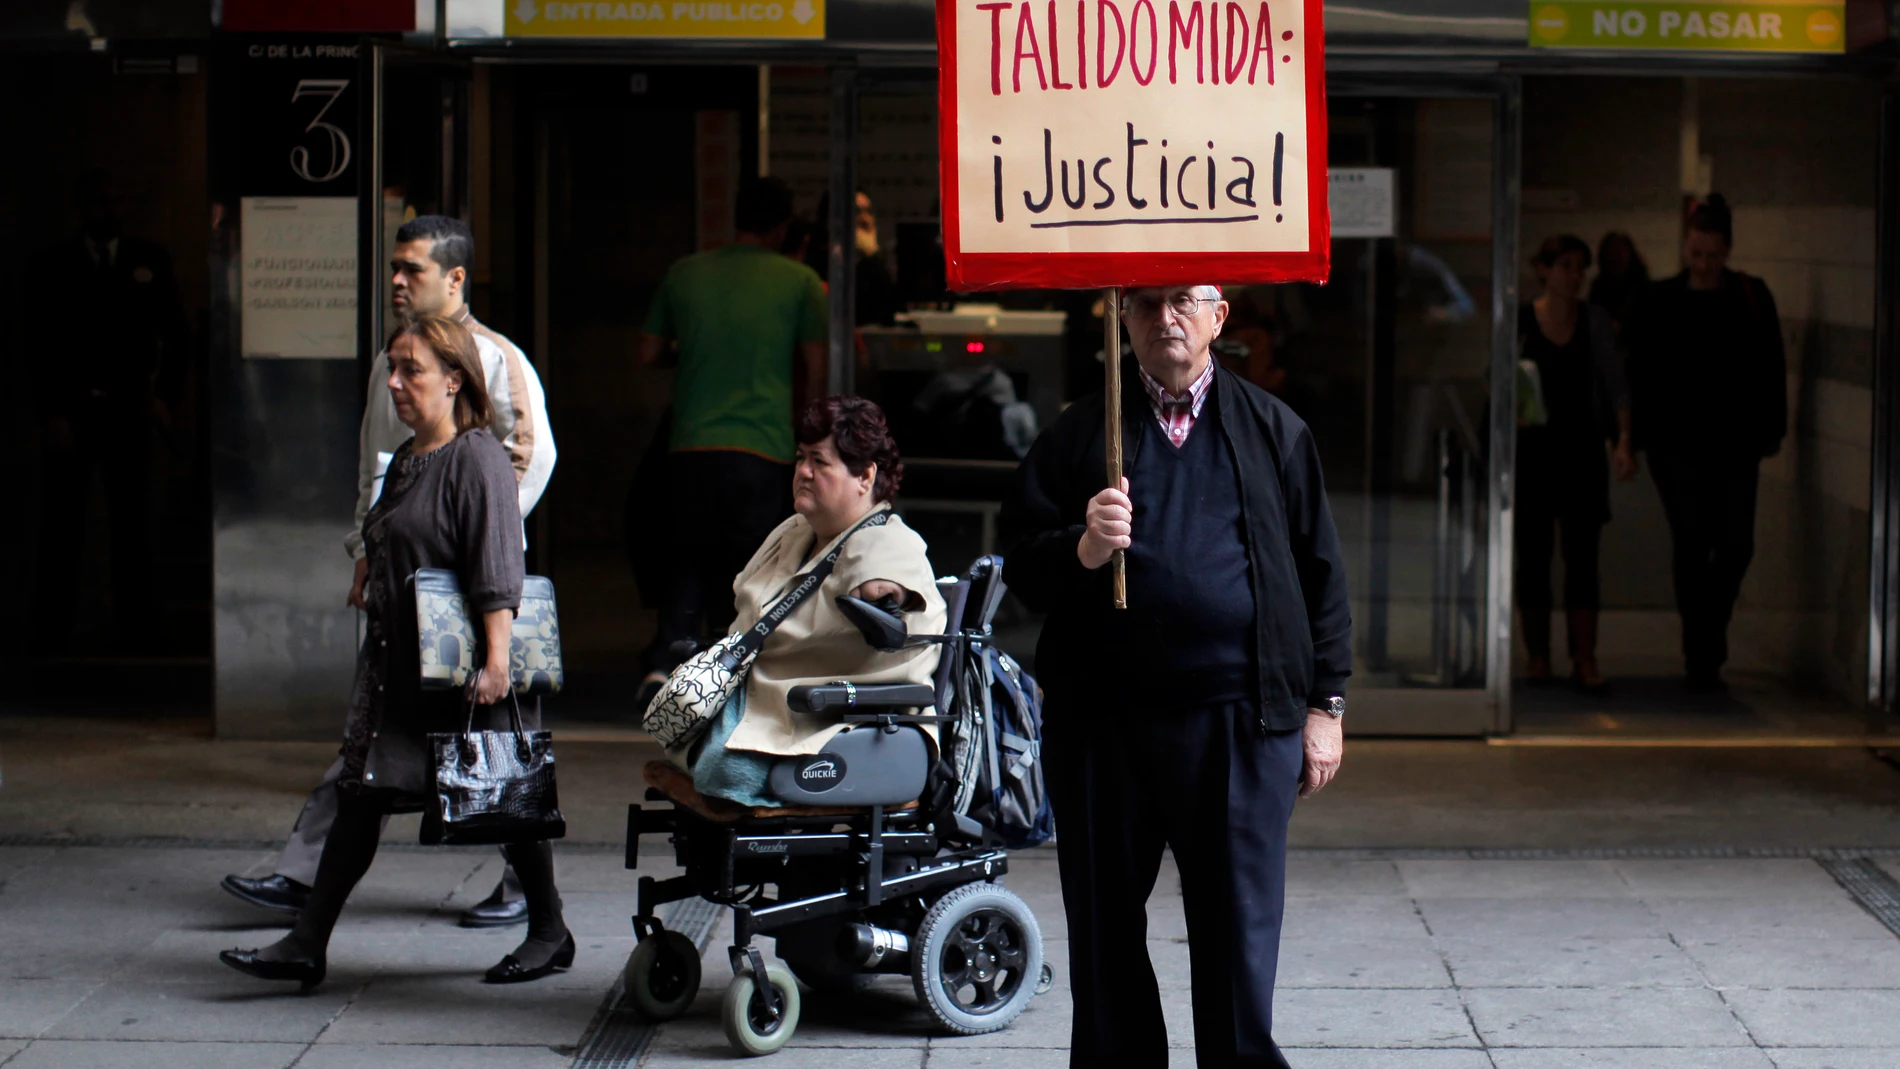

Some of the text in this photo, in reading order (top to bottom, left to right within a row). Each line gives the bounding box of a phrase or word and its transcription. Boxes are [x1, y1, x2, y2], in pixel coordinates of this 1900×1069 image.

[544, 2, 784, 21] ENTRADA PUBLICO
[1593, 9, 1782, 39] NO PASAR
[248, 44, 264, 58] C/
[267, 44, 288, 58] DE
[292, 44, 312, 58] LA
[976, 0, 1293, 95] TALIDOMIDA:
[290, 79, 351, 182] 3
[769, 575, 817, 621] COLLECTION
[802, 769, 837, 779] QUICKIE
